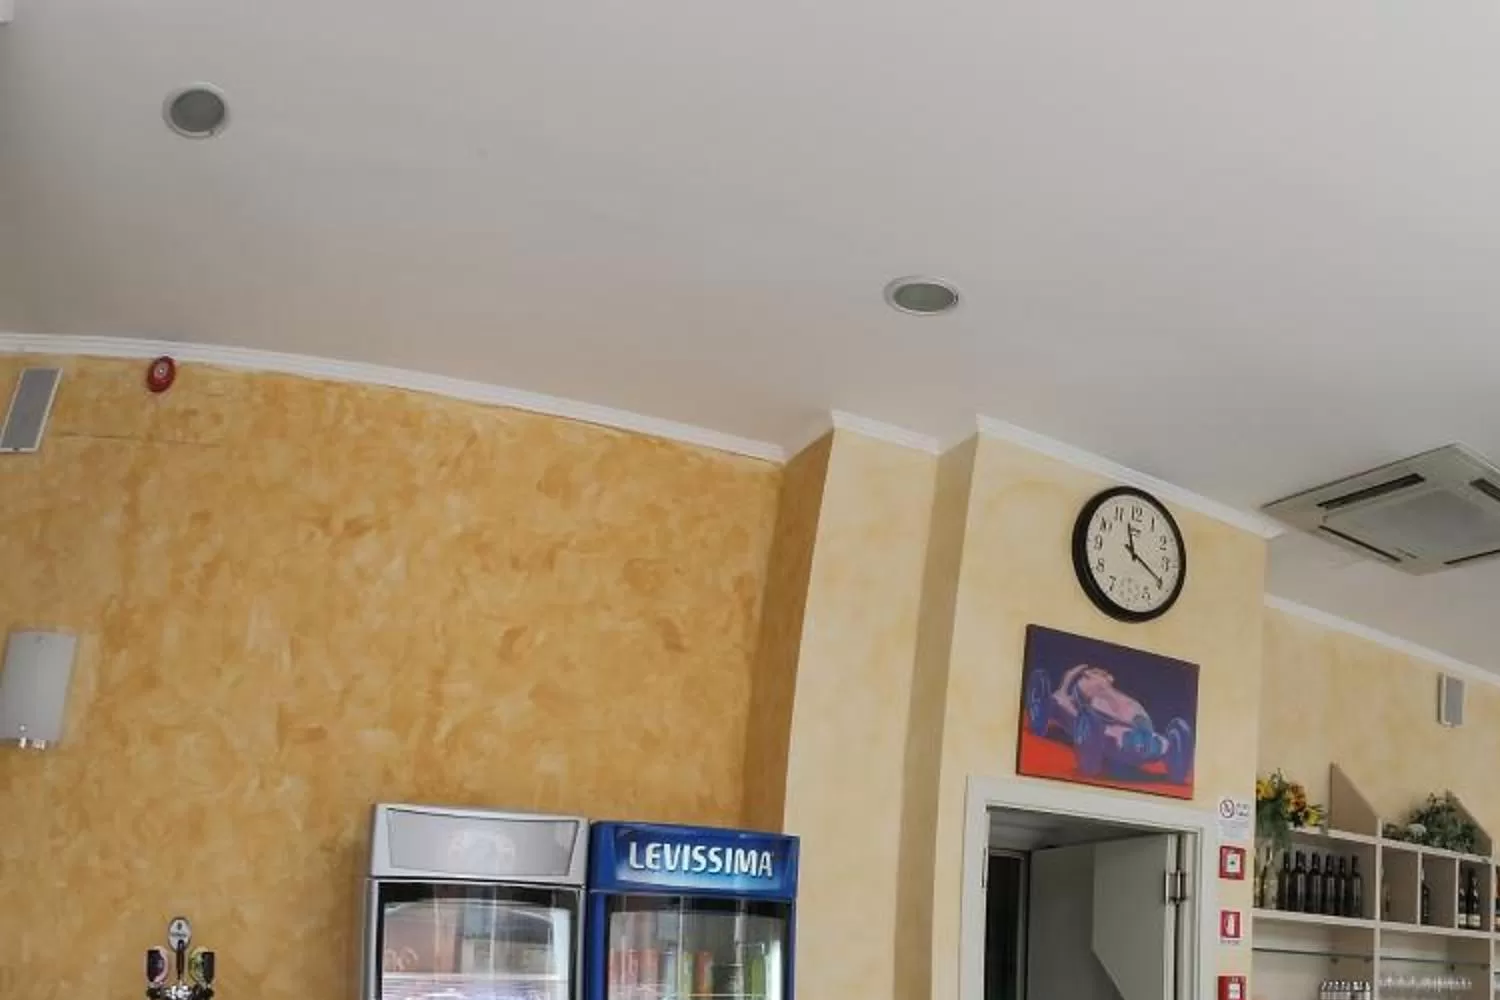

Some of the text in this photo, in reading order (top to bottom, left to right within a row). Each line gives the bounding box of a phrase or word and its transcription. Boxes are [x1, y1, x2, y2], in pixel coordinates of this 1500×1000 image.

[1131, 505, 1143, 523] 12
[1160, 536, 1167, 551] 2
[629, 841, 773, 877] LEVISSIMA
